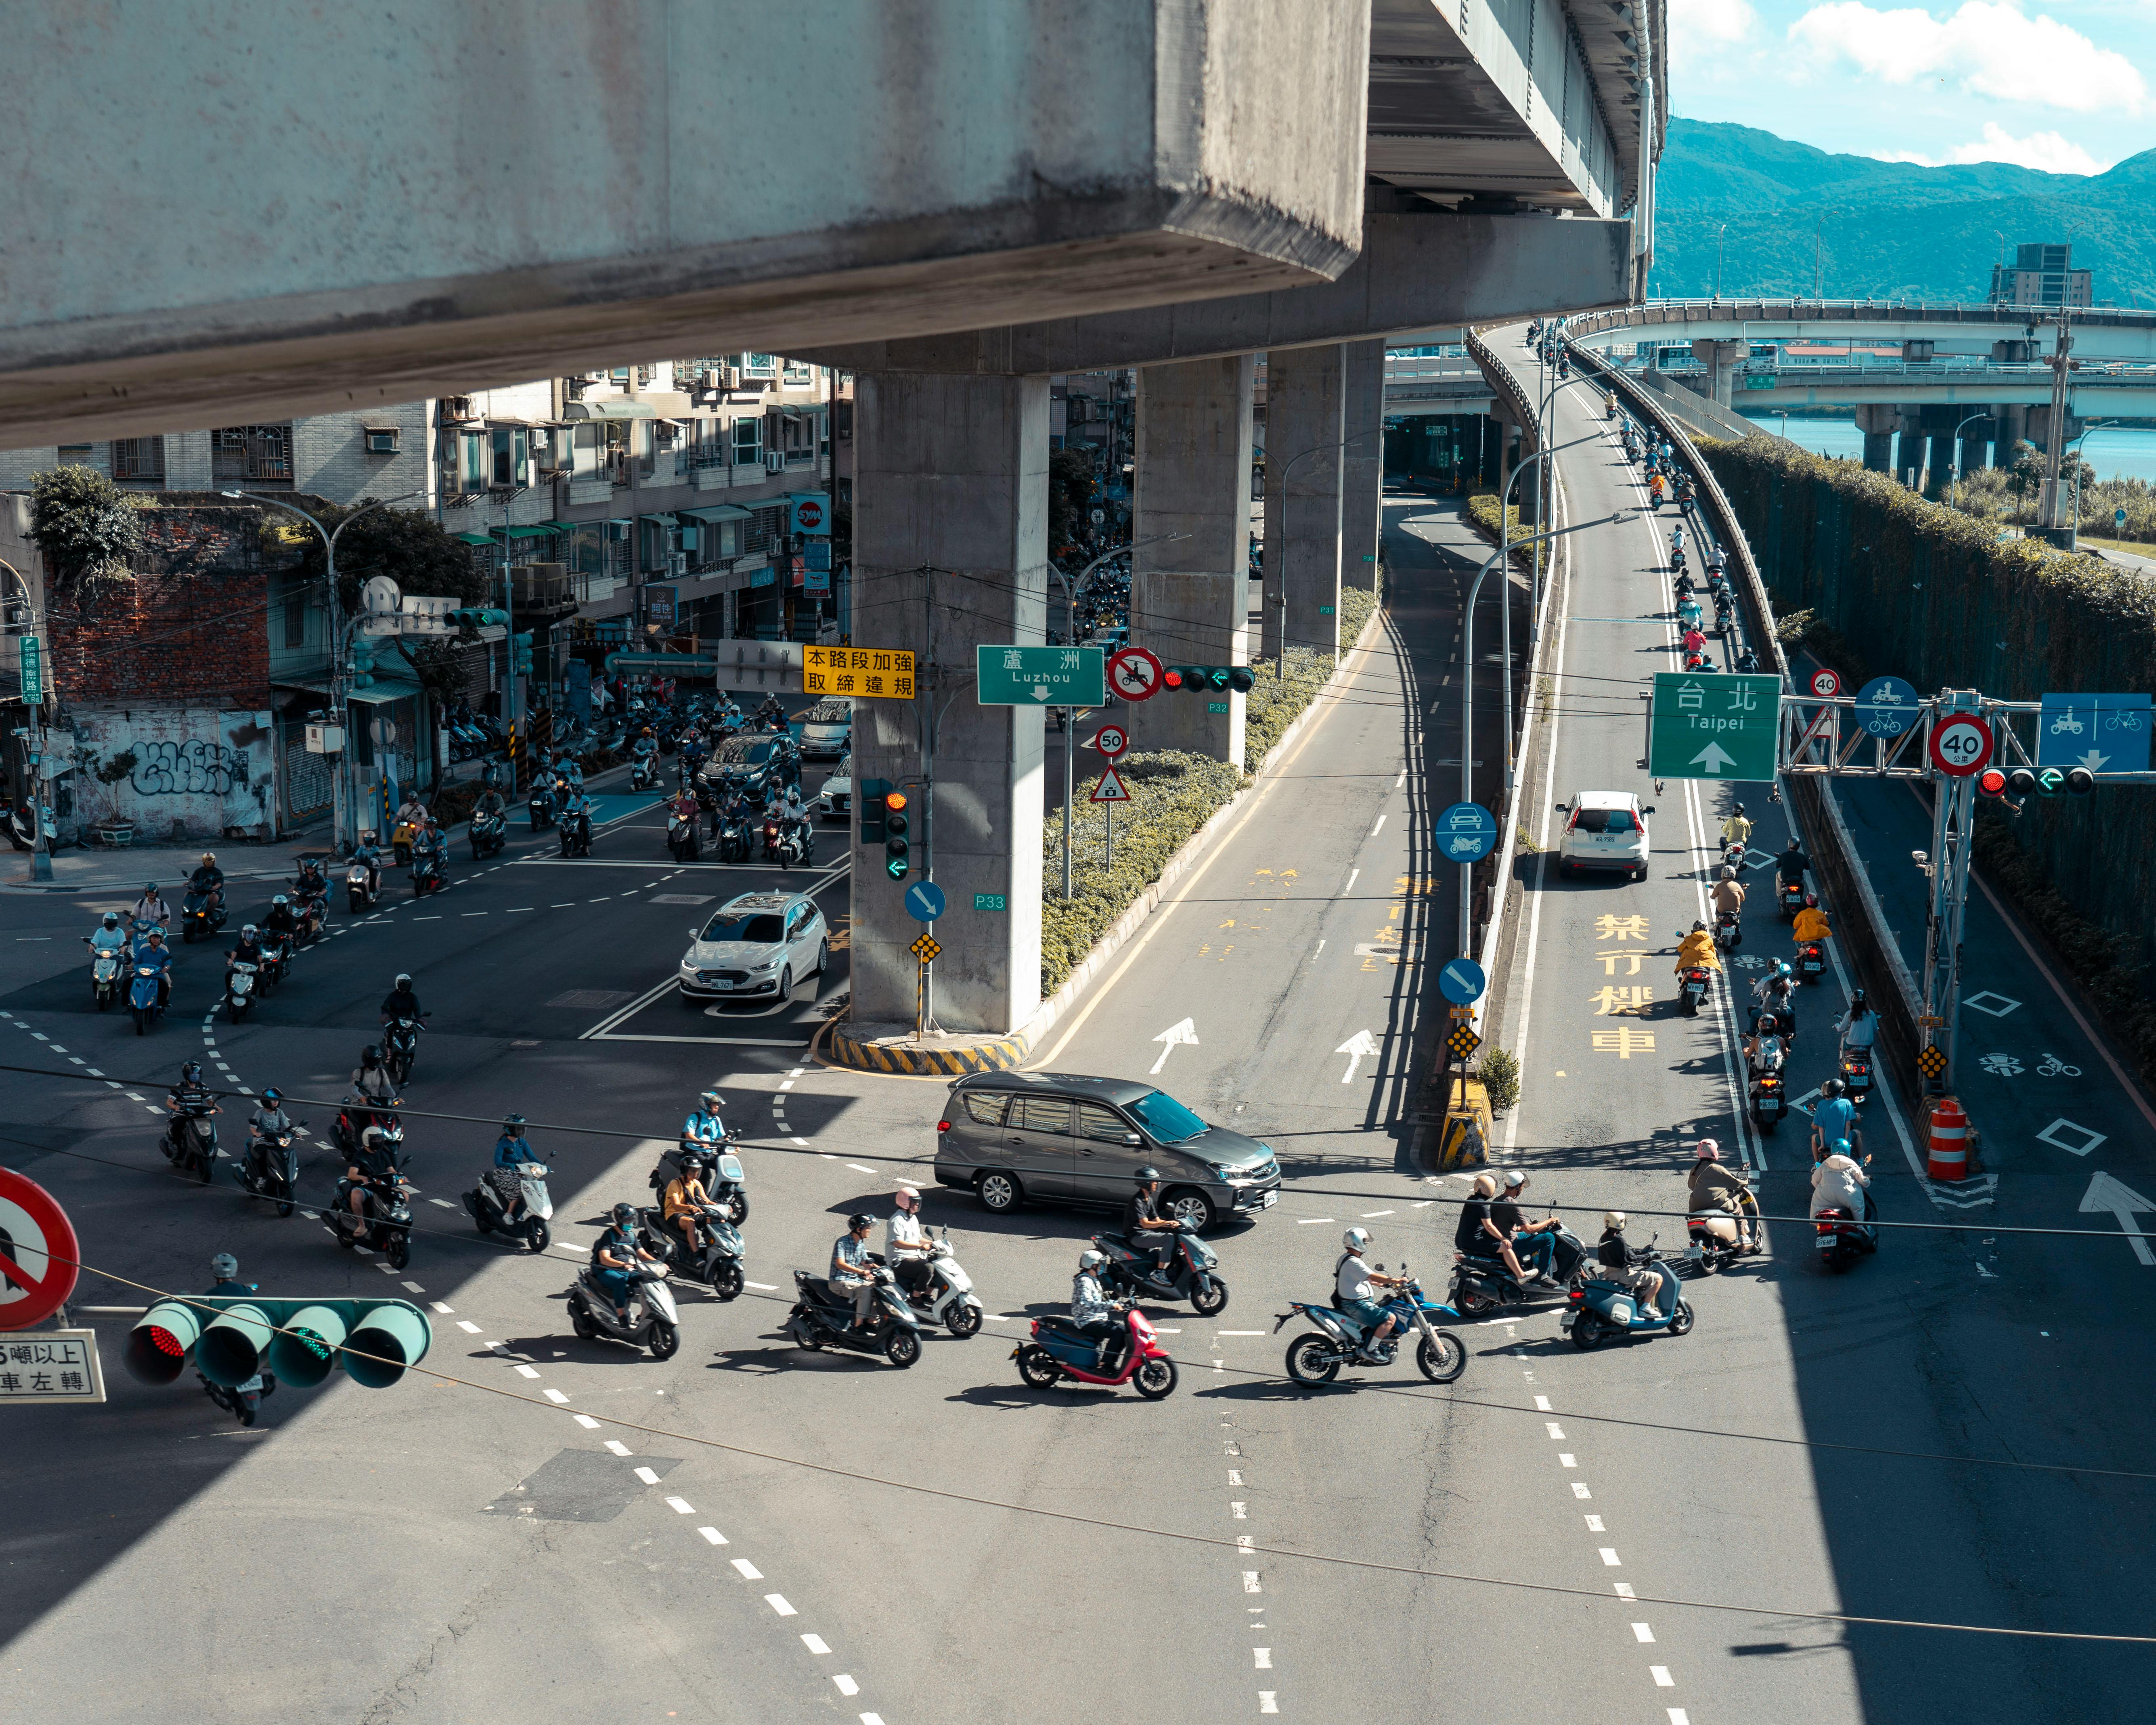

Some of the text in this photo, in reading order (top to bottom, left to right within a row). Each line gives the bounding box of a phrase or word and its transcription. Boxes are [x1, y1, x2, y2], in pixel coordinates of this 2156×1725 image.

[797, 510, 822, 522] SYM
[25, 647, 37, 691] 福德南路
[808, 649, 912, 672] 本路段加強
[1003, 649, 1079, 670] 蘆洲
[808, 673, 912, 695] 取締違規
[1012, 671, 1070, 683] Luzhou
[1816, 679, 1835, 690] 40
[1677, 679, 1757, 711] 台北
[1209, 704, 1227, 712] P32
[1688, 713, 1743, 733] Taipei
[1102, 735, 1121, 747] 50
[1943, 734, 1979, 755] 40
[976, 896, 1004, 908] P33
[1588, 914, 1656, 1059] 禁行機車
[1817, 1238, 1836, 1247] 376-HPY
[0, 1345, 80, 1365] 5噸以上
[0, 1371, 84, 1392] 車左轉
